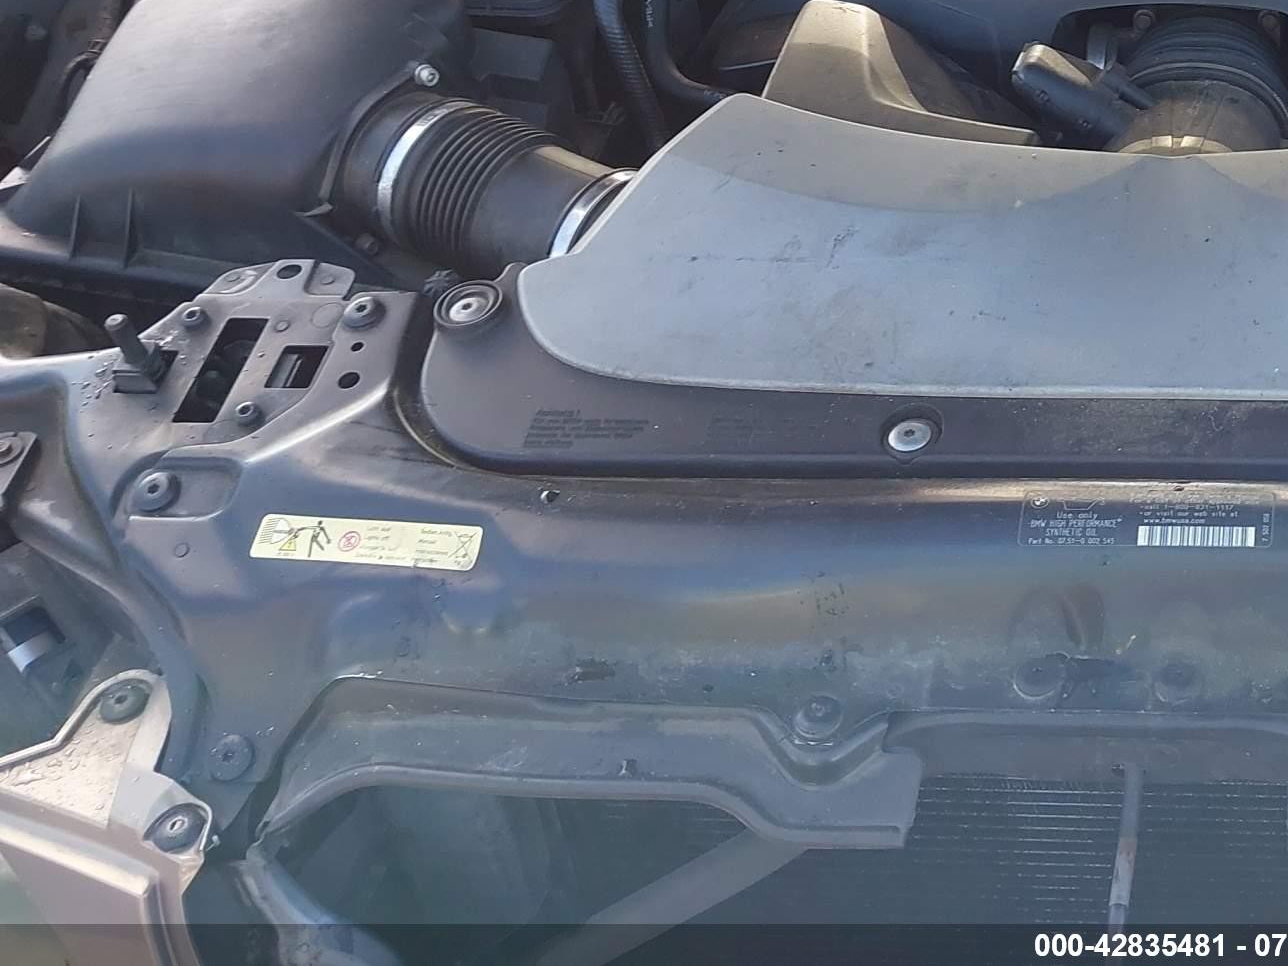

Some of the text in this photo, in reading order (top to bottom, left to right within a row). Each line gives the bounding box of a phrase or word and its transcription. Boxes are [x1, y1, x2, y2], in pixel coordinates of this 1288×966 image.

[1056, 511, 1098, 521] Use only
[1030, 519, 1047, 527] BMW
[1049, 519, 1067, 527] HIGH
[1045, 528, 1097, 536] SYNTHETIC OIL
